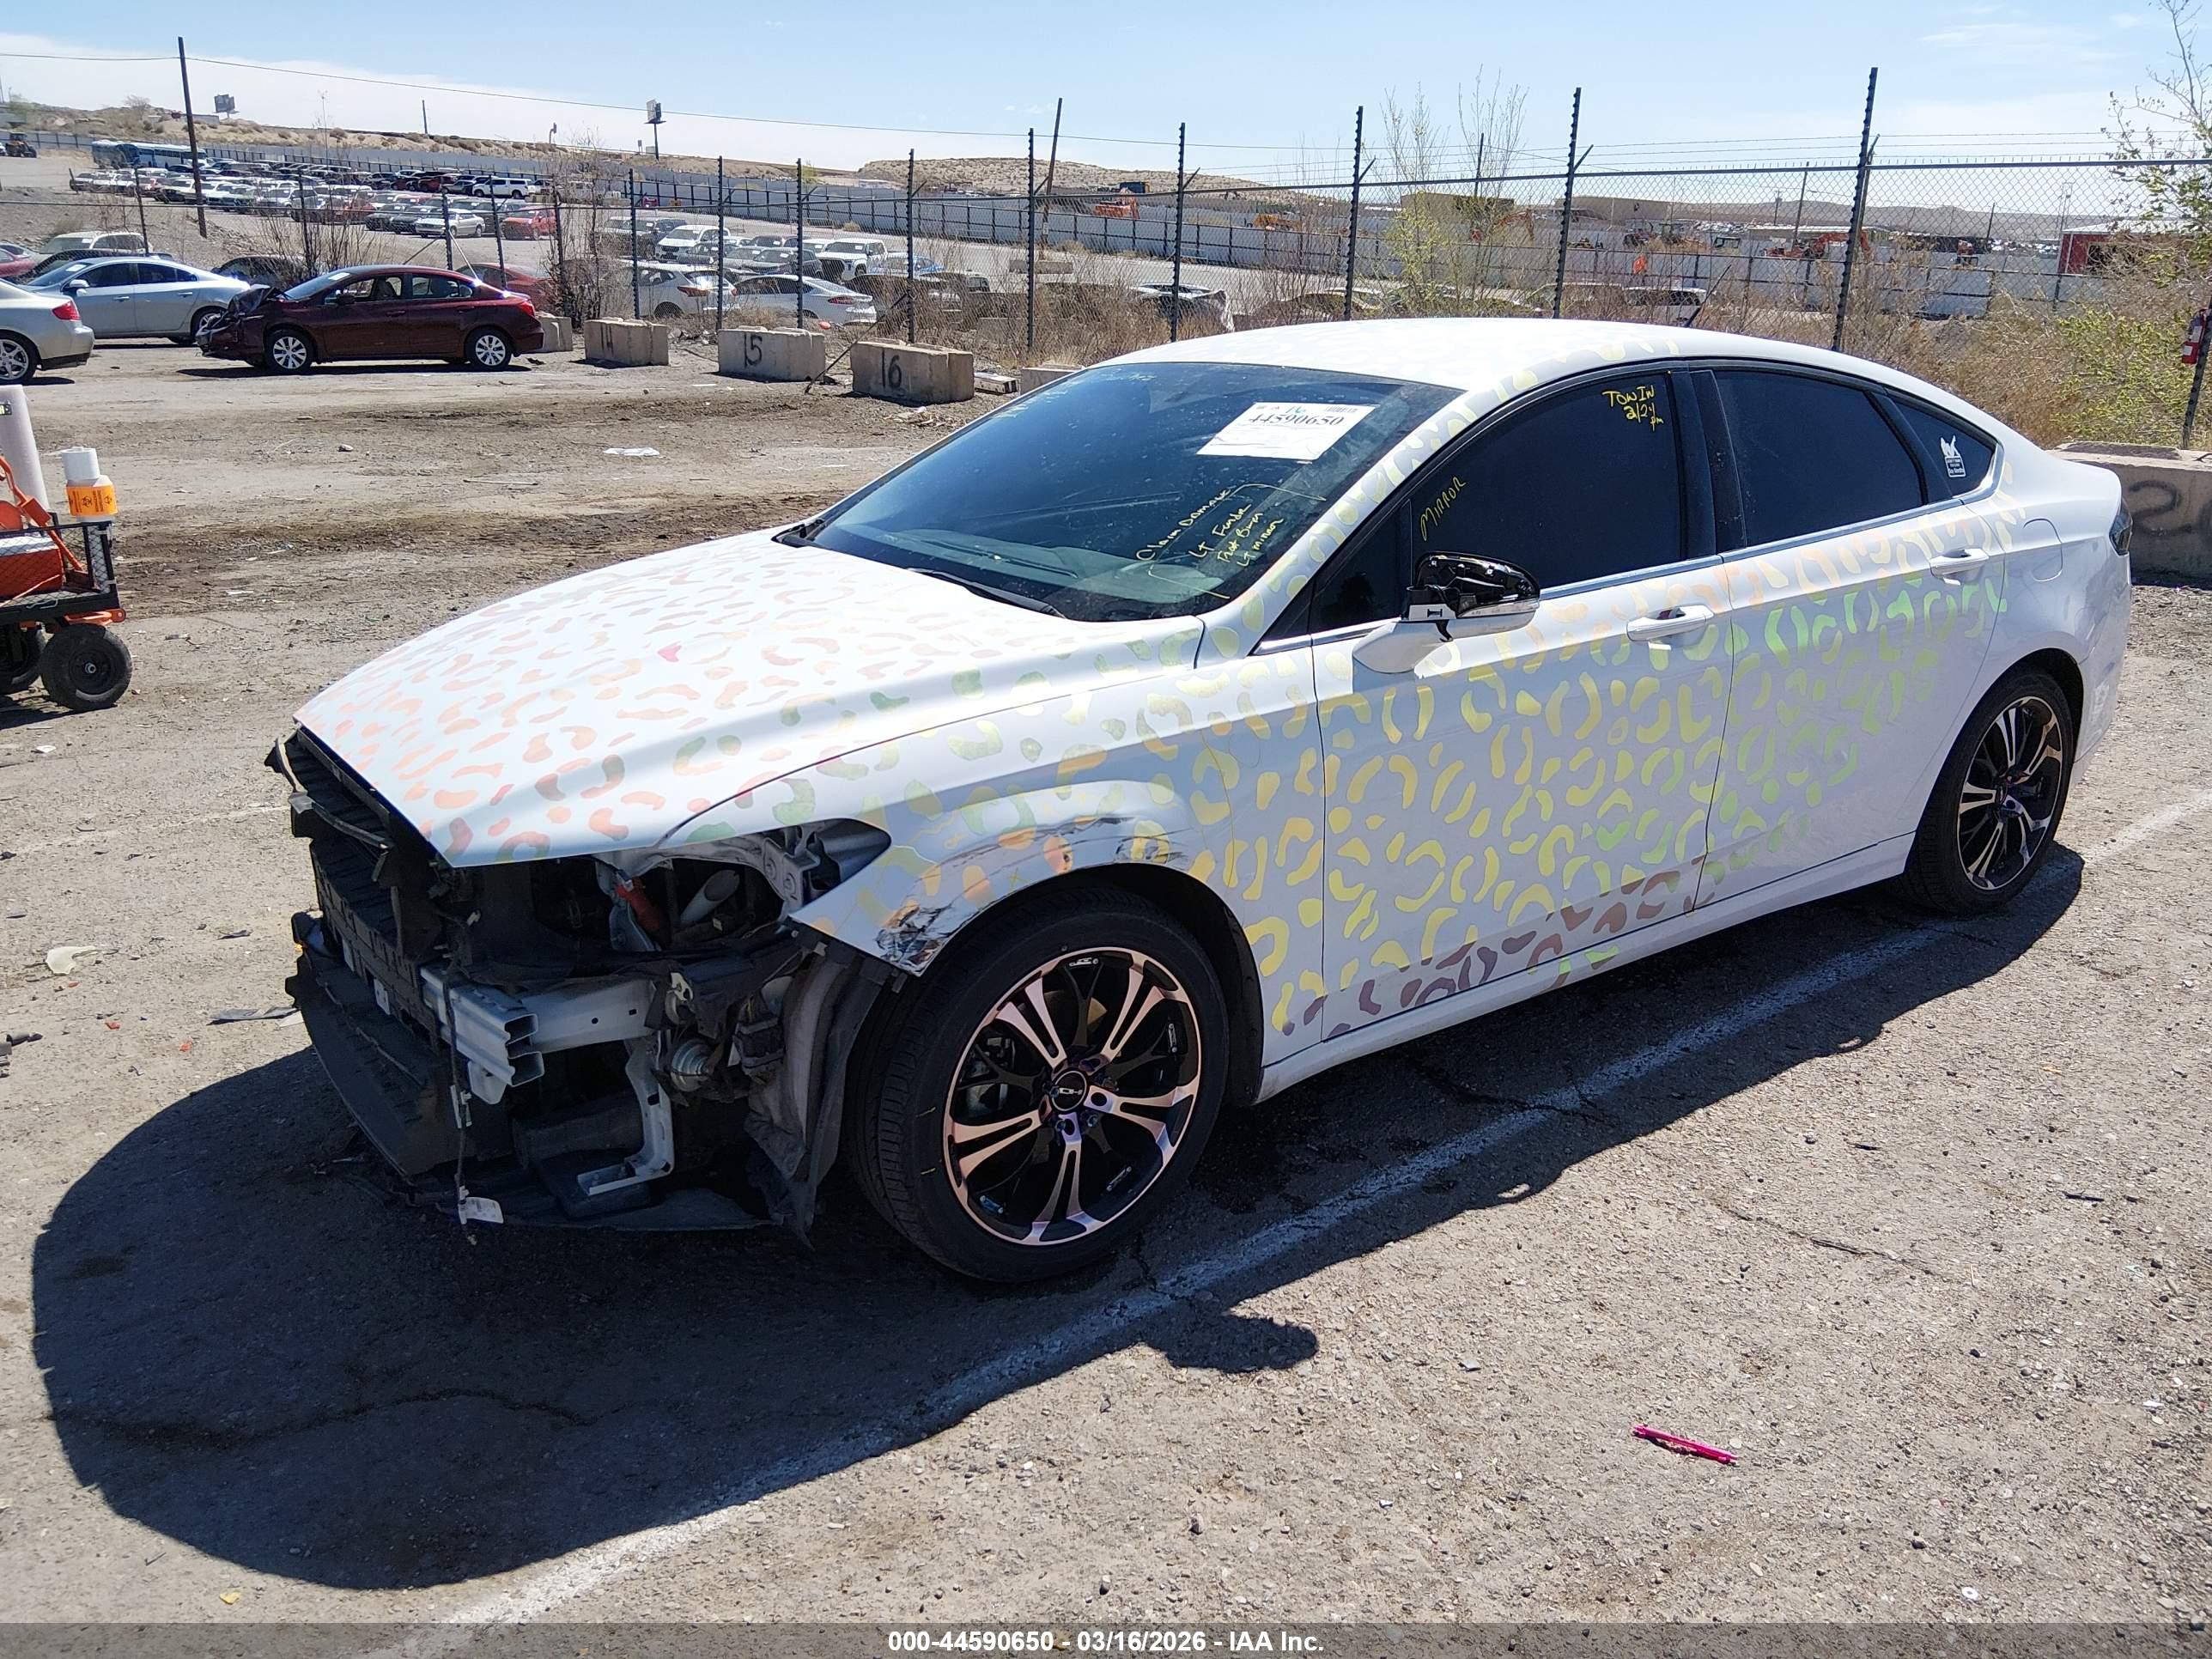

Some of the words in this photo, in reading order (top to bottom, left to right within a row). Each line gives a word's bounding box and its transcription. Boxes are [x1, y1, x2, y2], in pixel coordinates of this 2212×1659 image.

[744, 332, 763, 369] 15
[881, 349, 902, 389] 16
[1601, 390, 1638, 408] TOW
[1636, 384, 1656, 402] IN
[1248, 413, 1346, 426] 44590650
